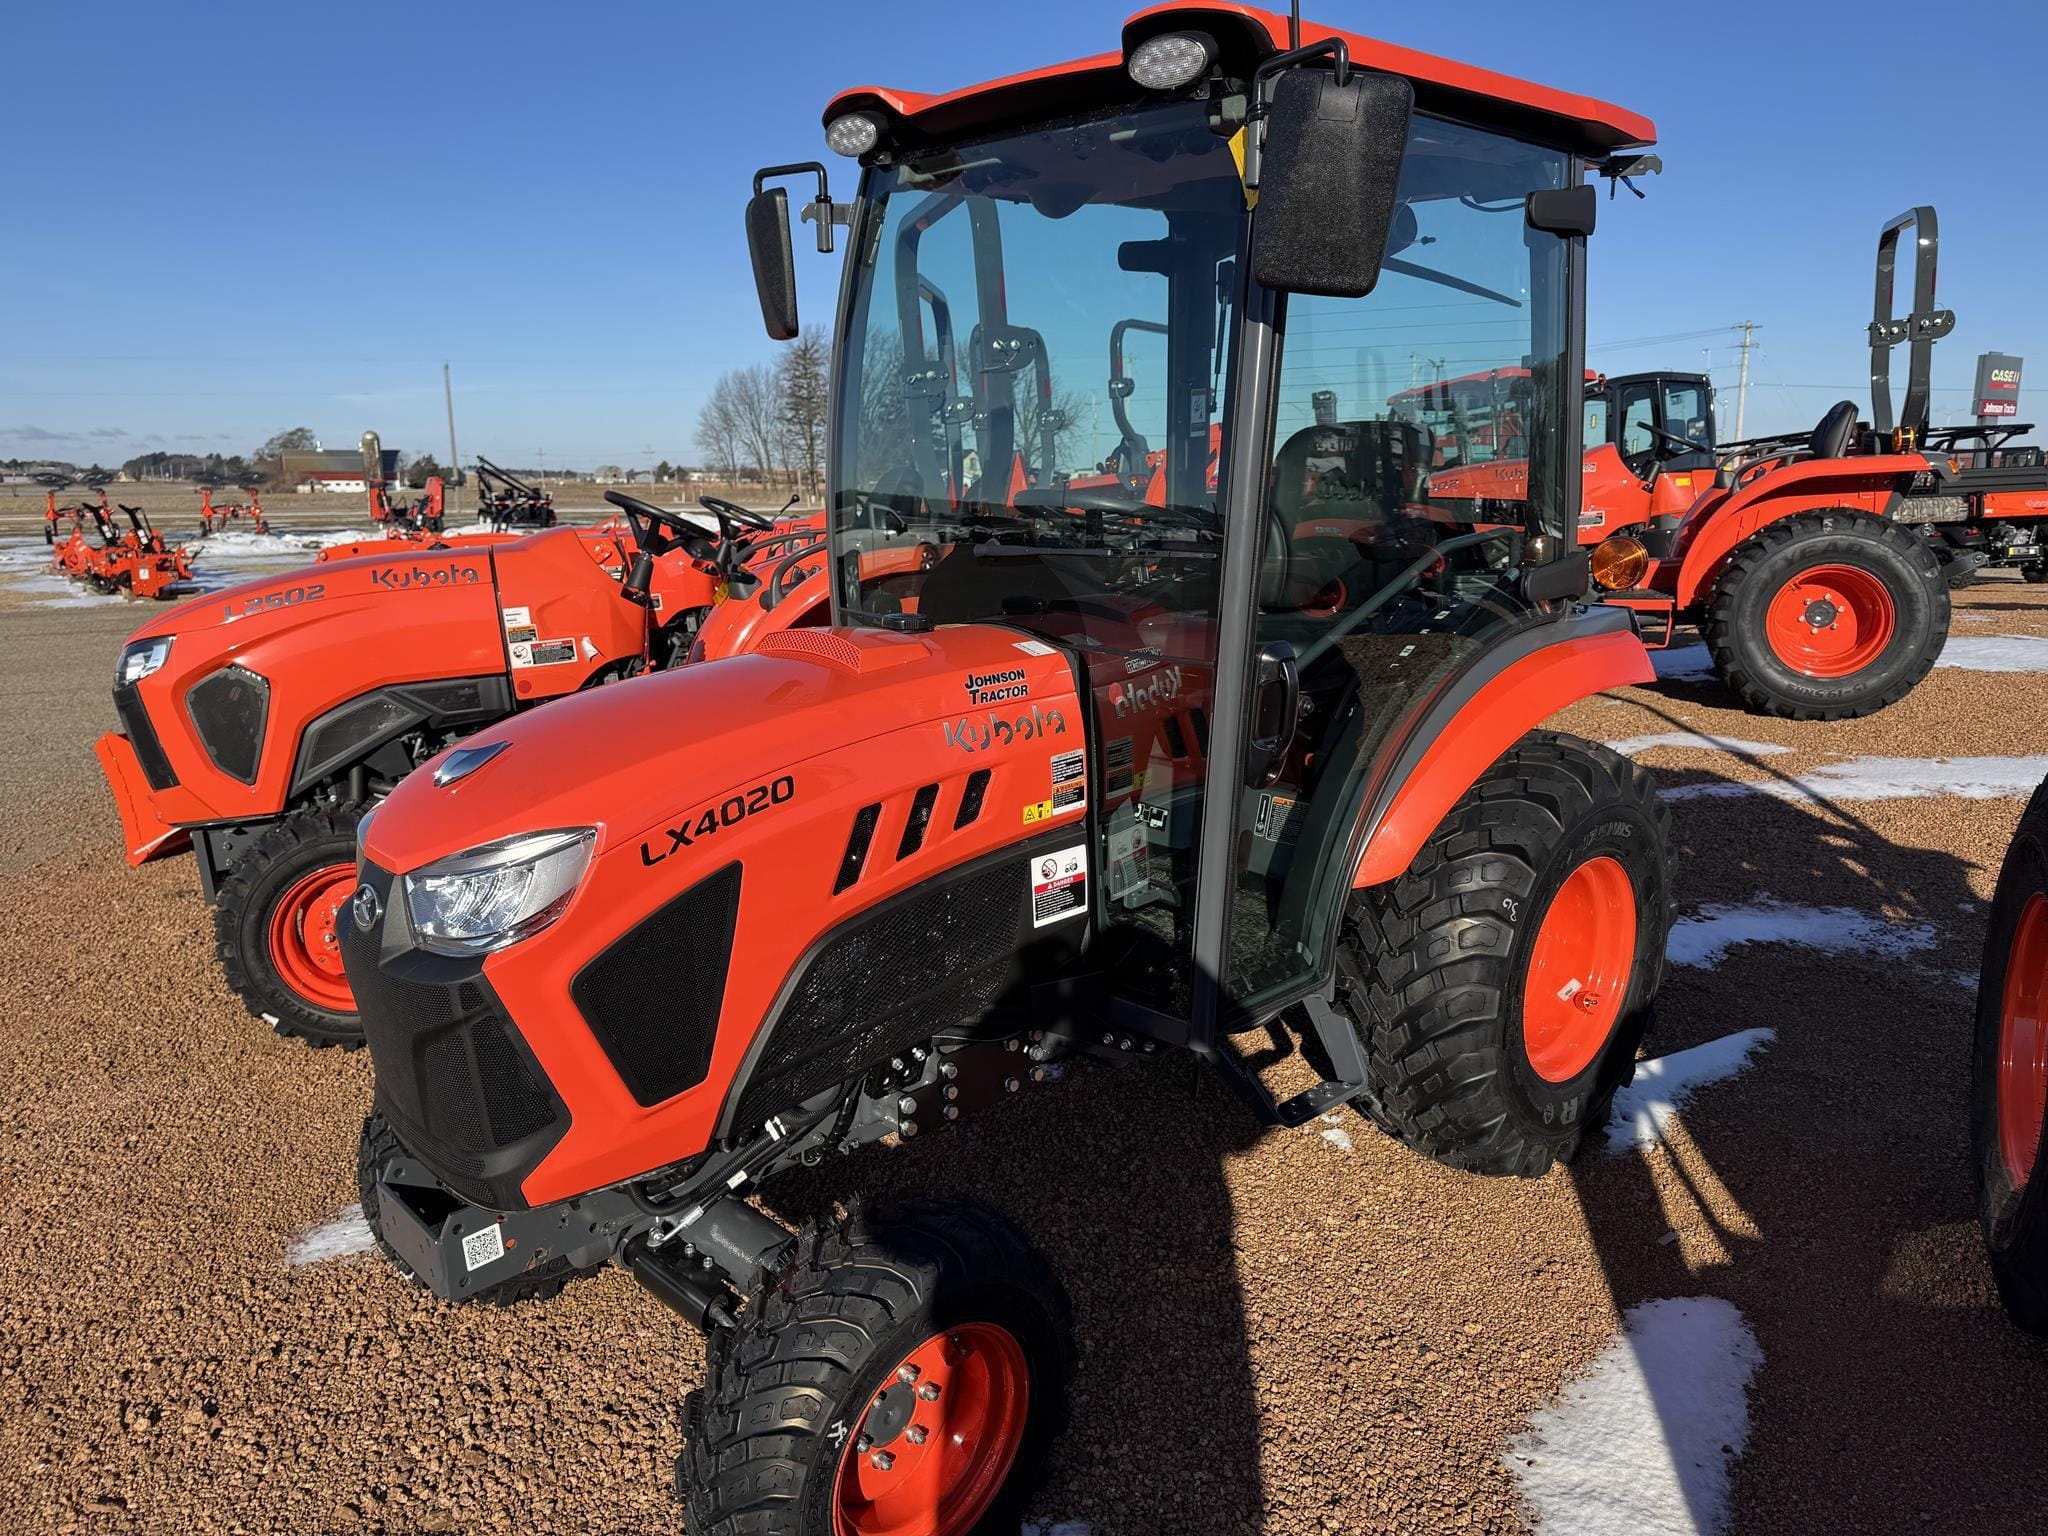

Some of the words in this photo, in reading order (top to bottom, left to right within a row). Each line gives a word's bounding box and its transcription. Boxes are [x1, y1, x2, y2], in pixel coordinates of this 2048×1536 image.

[1983, 402, 2003, 413] Johnson
[372, 564, 479, 590] Kubota
[223, 584, 325, 622] L2502
[964, 668, 1026, 690] JOHNSON
[968, 684, 1028, 705] TRACTOR
[942, 704, 1066, 753] Kubota
[639, 774, 795, 867] LX4020
[1053, 876, 1074, 888] DANGER
